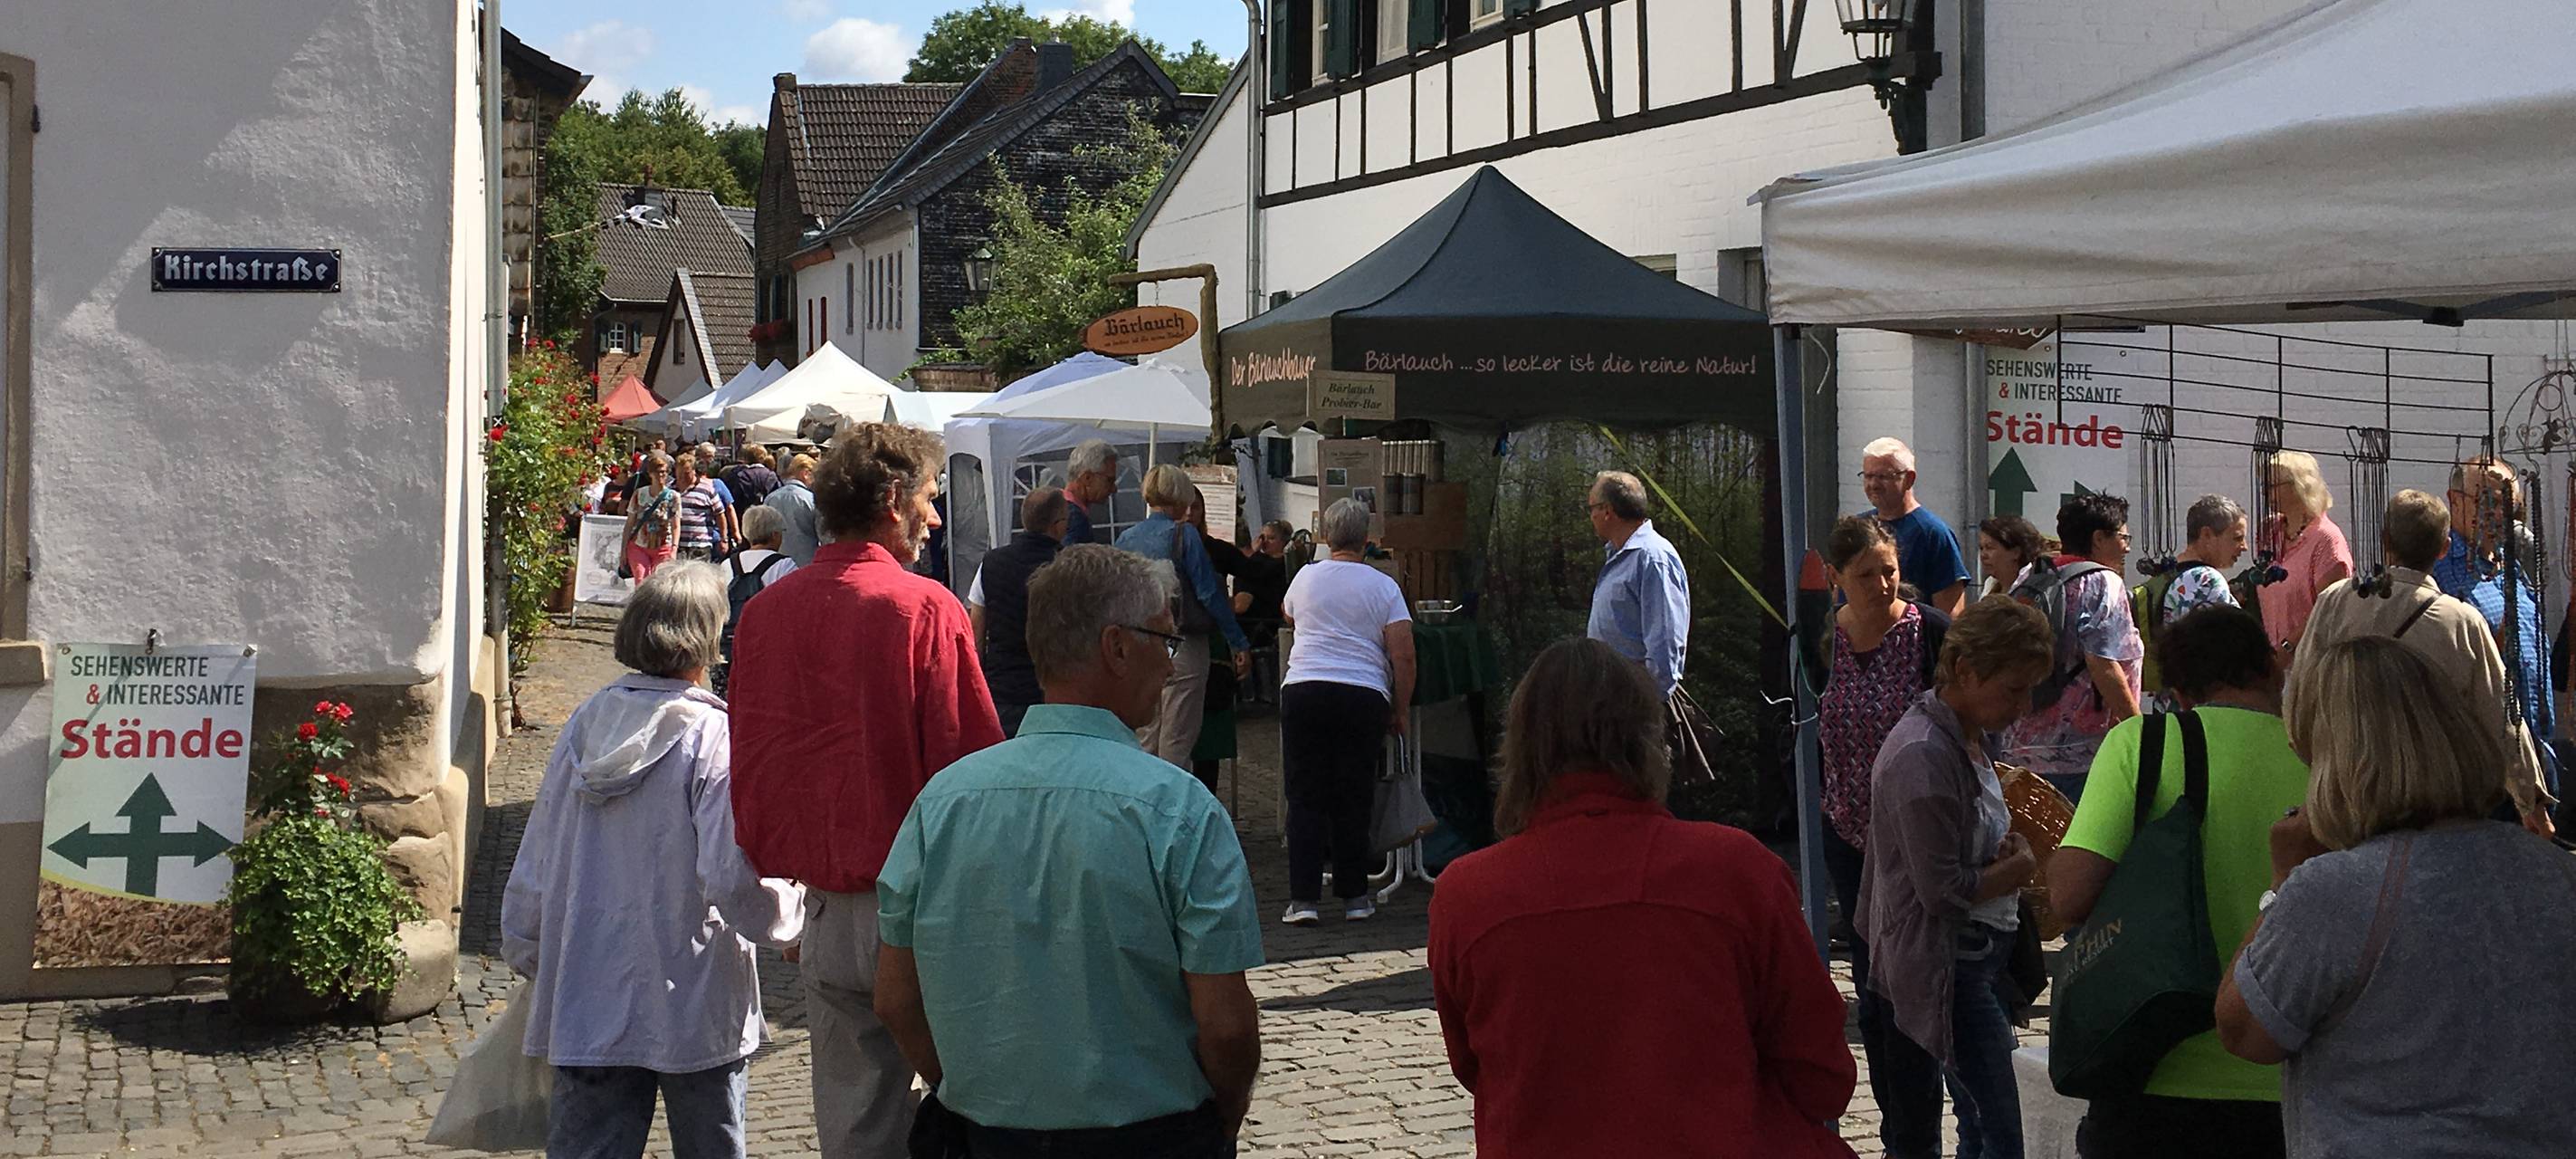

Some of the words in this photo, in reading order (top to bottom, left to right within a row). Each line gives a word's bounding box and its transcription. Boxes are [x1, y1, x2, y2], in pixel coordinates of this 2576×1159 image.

[165, 254, 329, 282] Kirchstraße
[1104, 312, 1185, 337] Bärlauch
[1232, 357, 1245, 387] Der
[1365, 350, 1454, 371] Bärlauch
[1570, 353, 1595, 372] ist
[1601, 352, 1635, 373] die
[1639, 357, 1690, 373] reine
[1696, 354, 1756, 374] Natur!
[1986, 359, 2093, 380] SEHENSWERTE
[1329, 383, 1375, 395] Bärlauch
[1999, 382, 2009, 398] &
[2015, 383, 2123, 403] INTERESSANTE
[1321, 396, 1382, 409] Probier-Bar
[1986, 410, 2123, 449] Stände
[71, 656, 209, 677] SEHENSWERTE
[86, 684, 100, 704] &
[107, 684, 244, 705] INTERESSANTE
[60, 718, 243, 759] Stände
